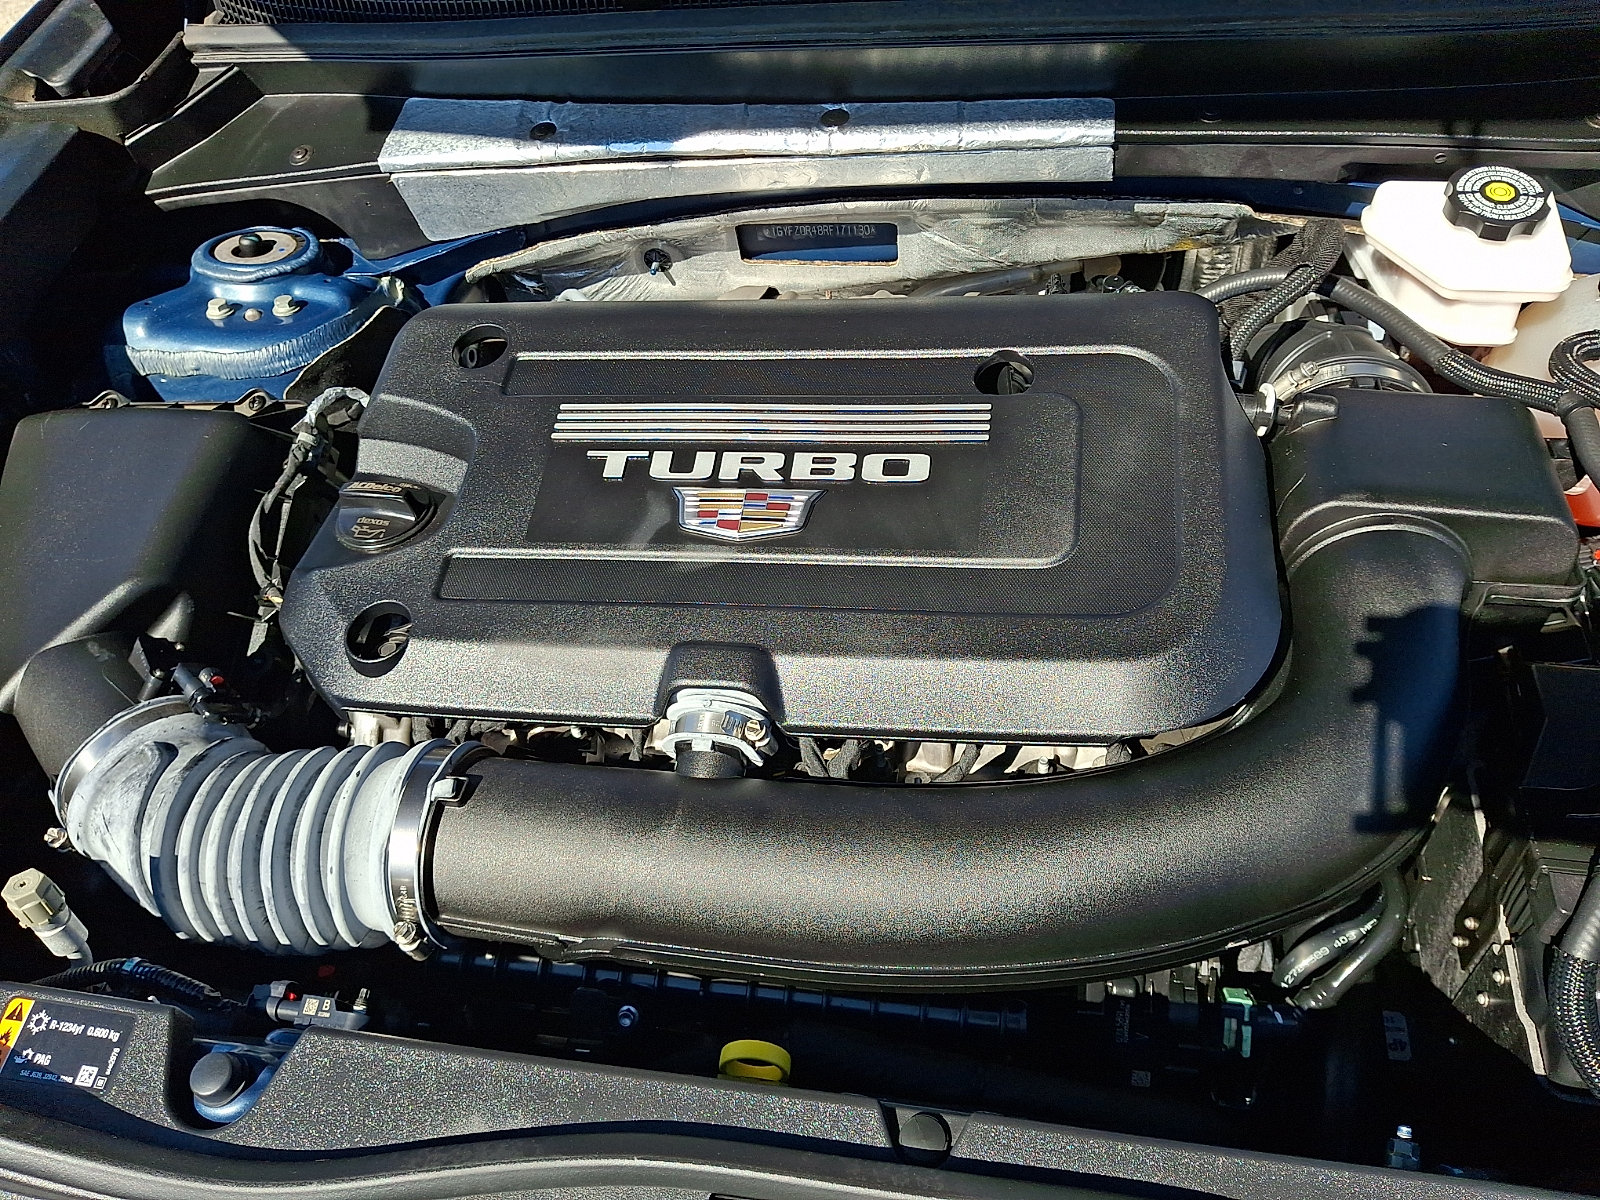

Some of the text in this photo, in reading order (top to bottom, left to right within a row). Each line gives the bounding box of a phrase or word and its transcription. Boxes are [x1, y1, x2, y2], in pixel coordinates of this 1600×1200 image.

[587, 450, 931, 482] TURBO
[347, 481, 402, 493] ACDelco
[356, 516, 390, 526] dexos
[322, 1000, 330, 1010] B
[49, 1020, 85, 1036] R-1234yf
[110, 1030, 120, 1042] kg
[34, 1052, 52, 1066] PAG
